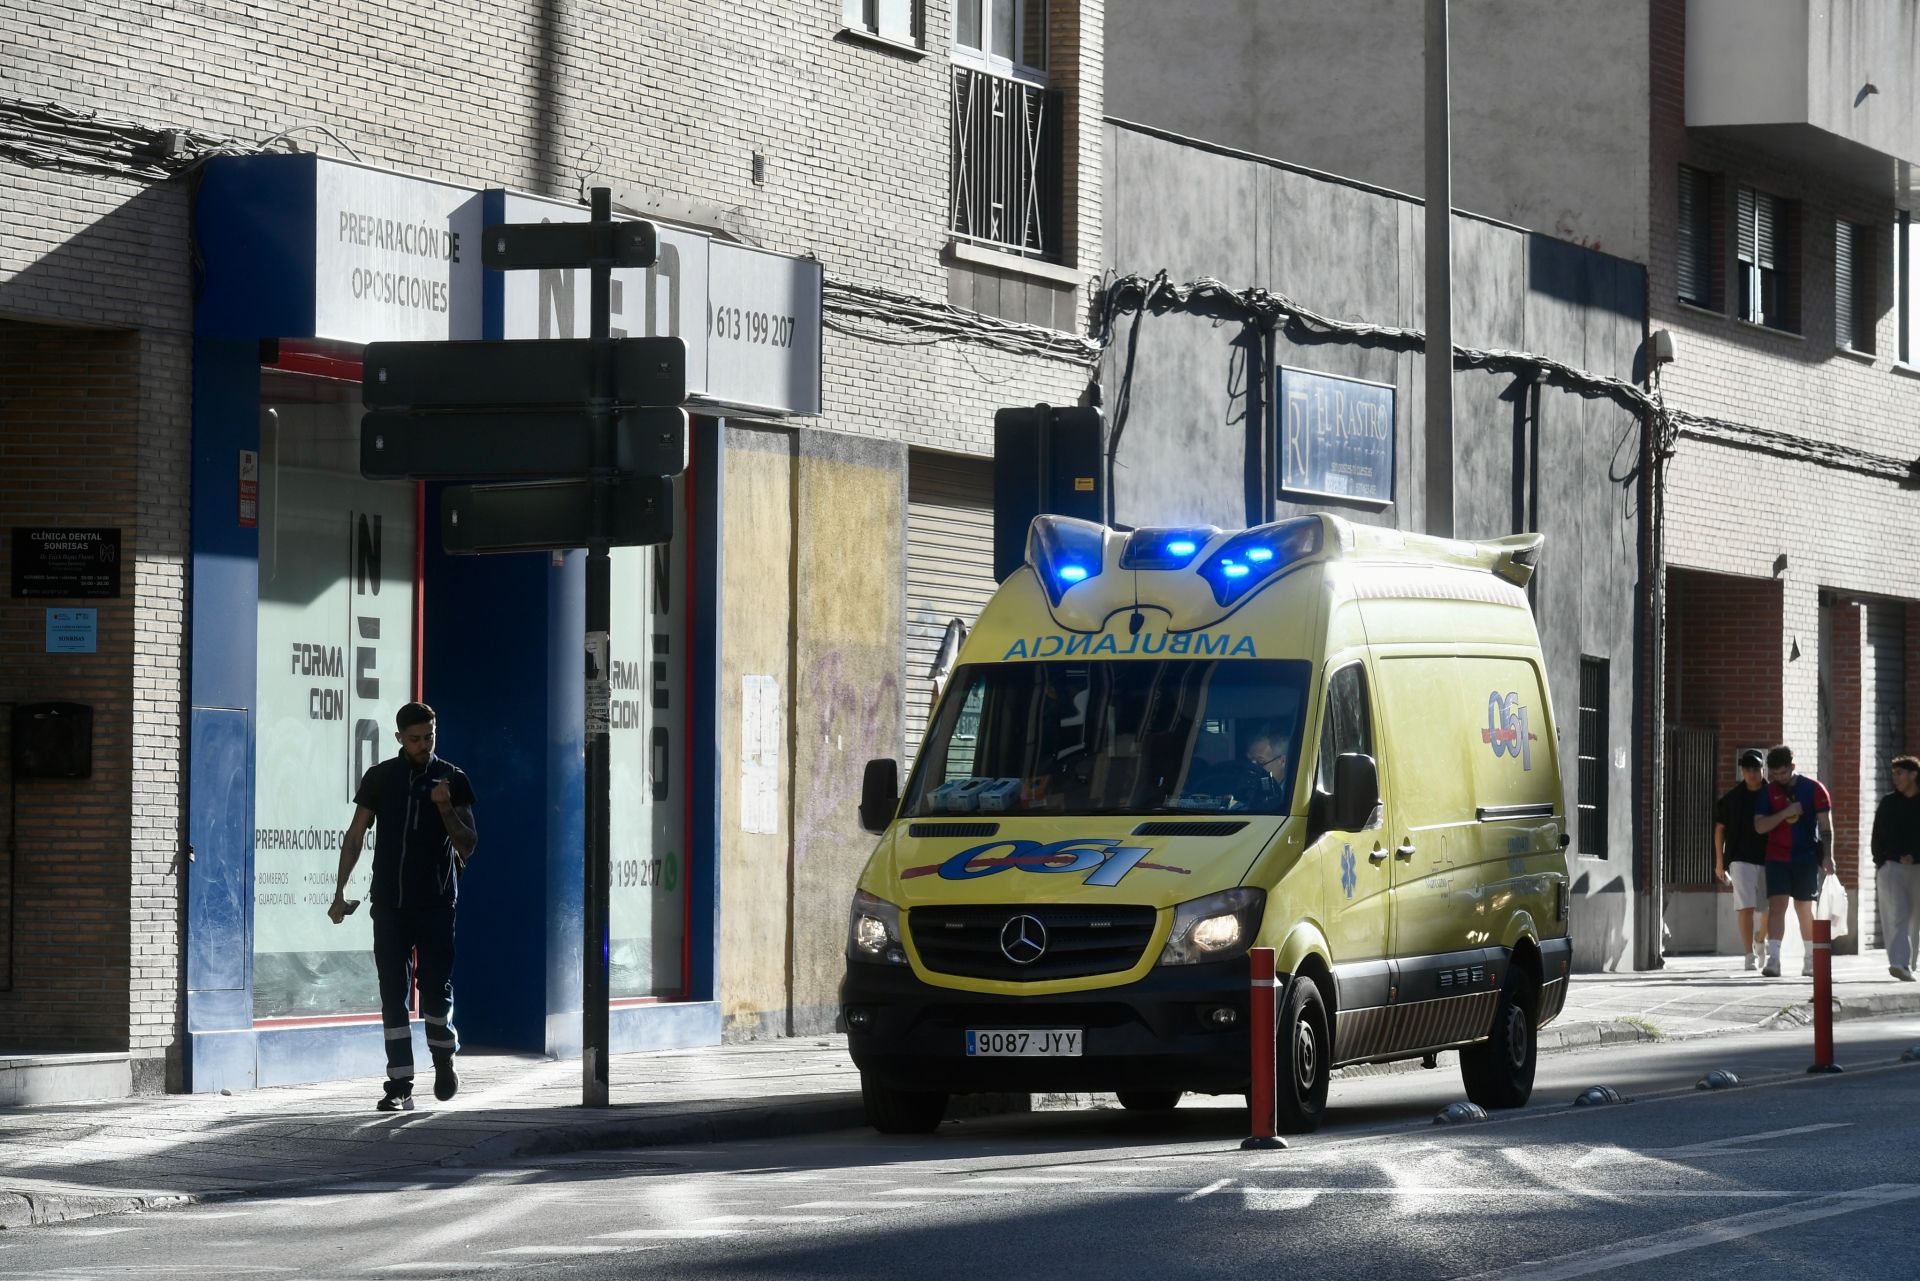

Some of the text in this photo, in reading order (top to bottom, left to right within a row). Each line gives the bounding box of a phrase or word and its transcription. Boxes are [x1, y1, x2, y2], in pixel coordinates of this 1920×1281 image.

[339, 210, 460, 264] PREPARACIÓN DE
[352, 267, 448, 313] OPOSICIONES
[716, 305, 795, 349] 613 199 207
[31, 530, 102, 541] CLÍNICA DENTAL
[43, 542, 89, 550] SONRISAS
[292, 642, 345, 678] FORMA
[611, 660, 640, 690] RMA
[309, 688, 344, 721] CION
[611, 700, 639, 729] CION
[1488, 690, 1531, 772] 061
[255, 825, 321, 850] PREPARACIÓN
[324, 830, 336, 850] DE
[617, 860, 637, 887] 199
[640, 859, 661, 887] 207
[937, 838, 1153, 887] 061
[258, 872, 289, 885] BOMBEROS
[308, 872, 329, 885] POLICÍA
[258, 893, 297, 905] GUARDIA CIVIL
[308, 892, 329, 905] POLICÍA
[979, 1033, 1030, 1053] 9087
[1038, 1033, 1076, 1053] JYY
